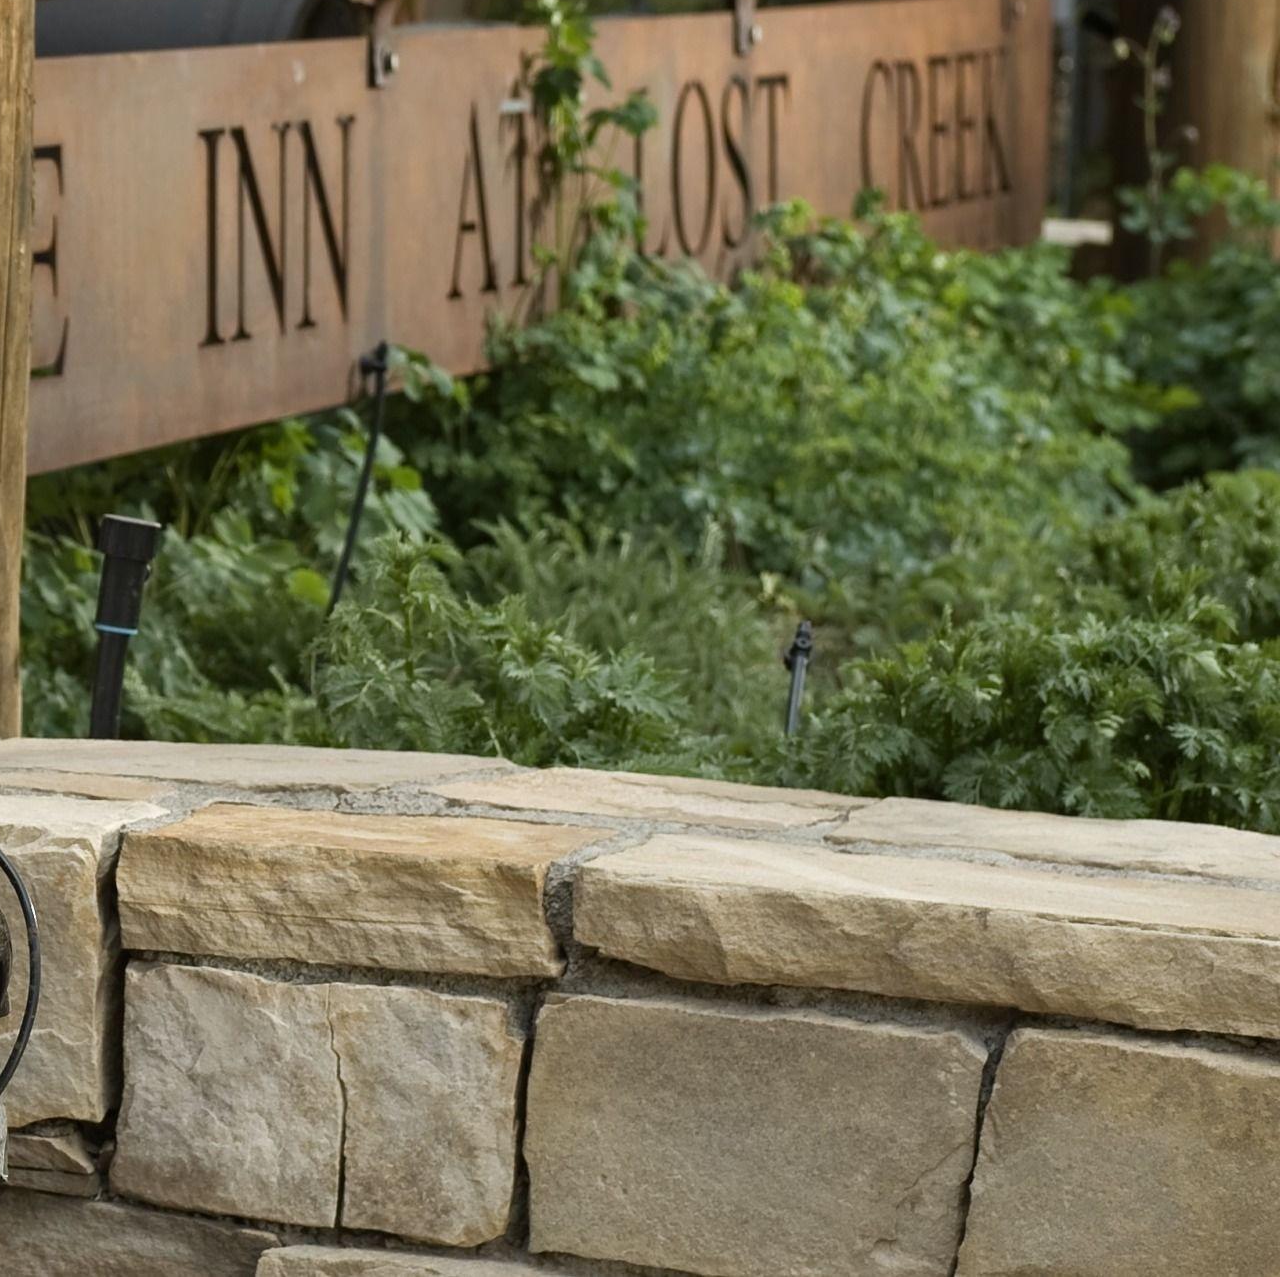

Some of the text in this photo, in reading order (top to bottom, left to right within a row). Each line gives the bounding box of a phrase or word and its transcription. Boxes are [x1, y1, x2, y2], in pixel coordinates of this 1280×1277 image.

[198, 114, 356, 347] INN
[446, 100, 533, 299] AT
[859, 47, 1011, 210] CREEK
